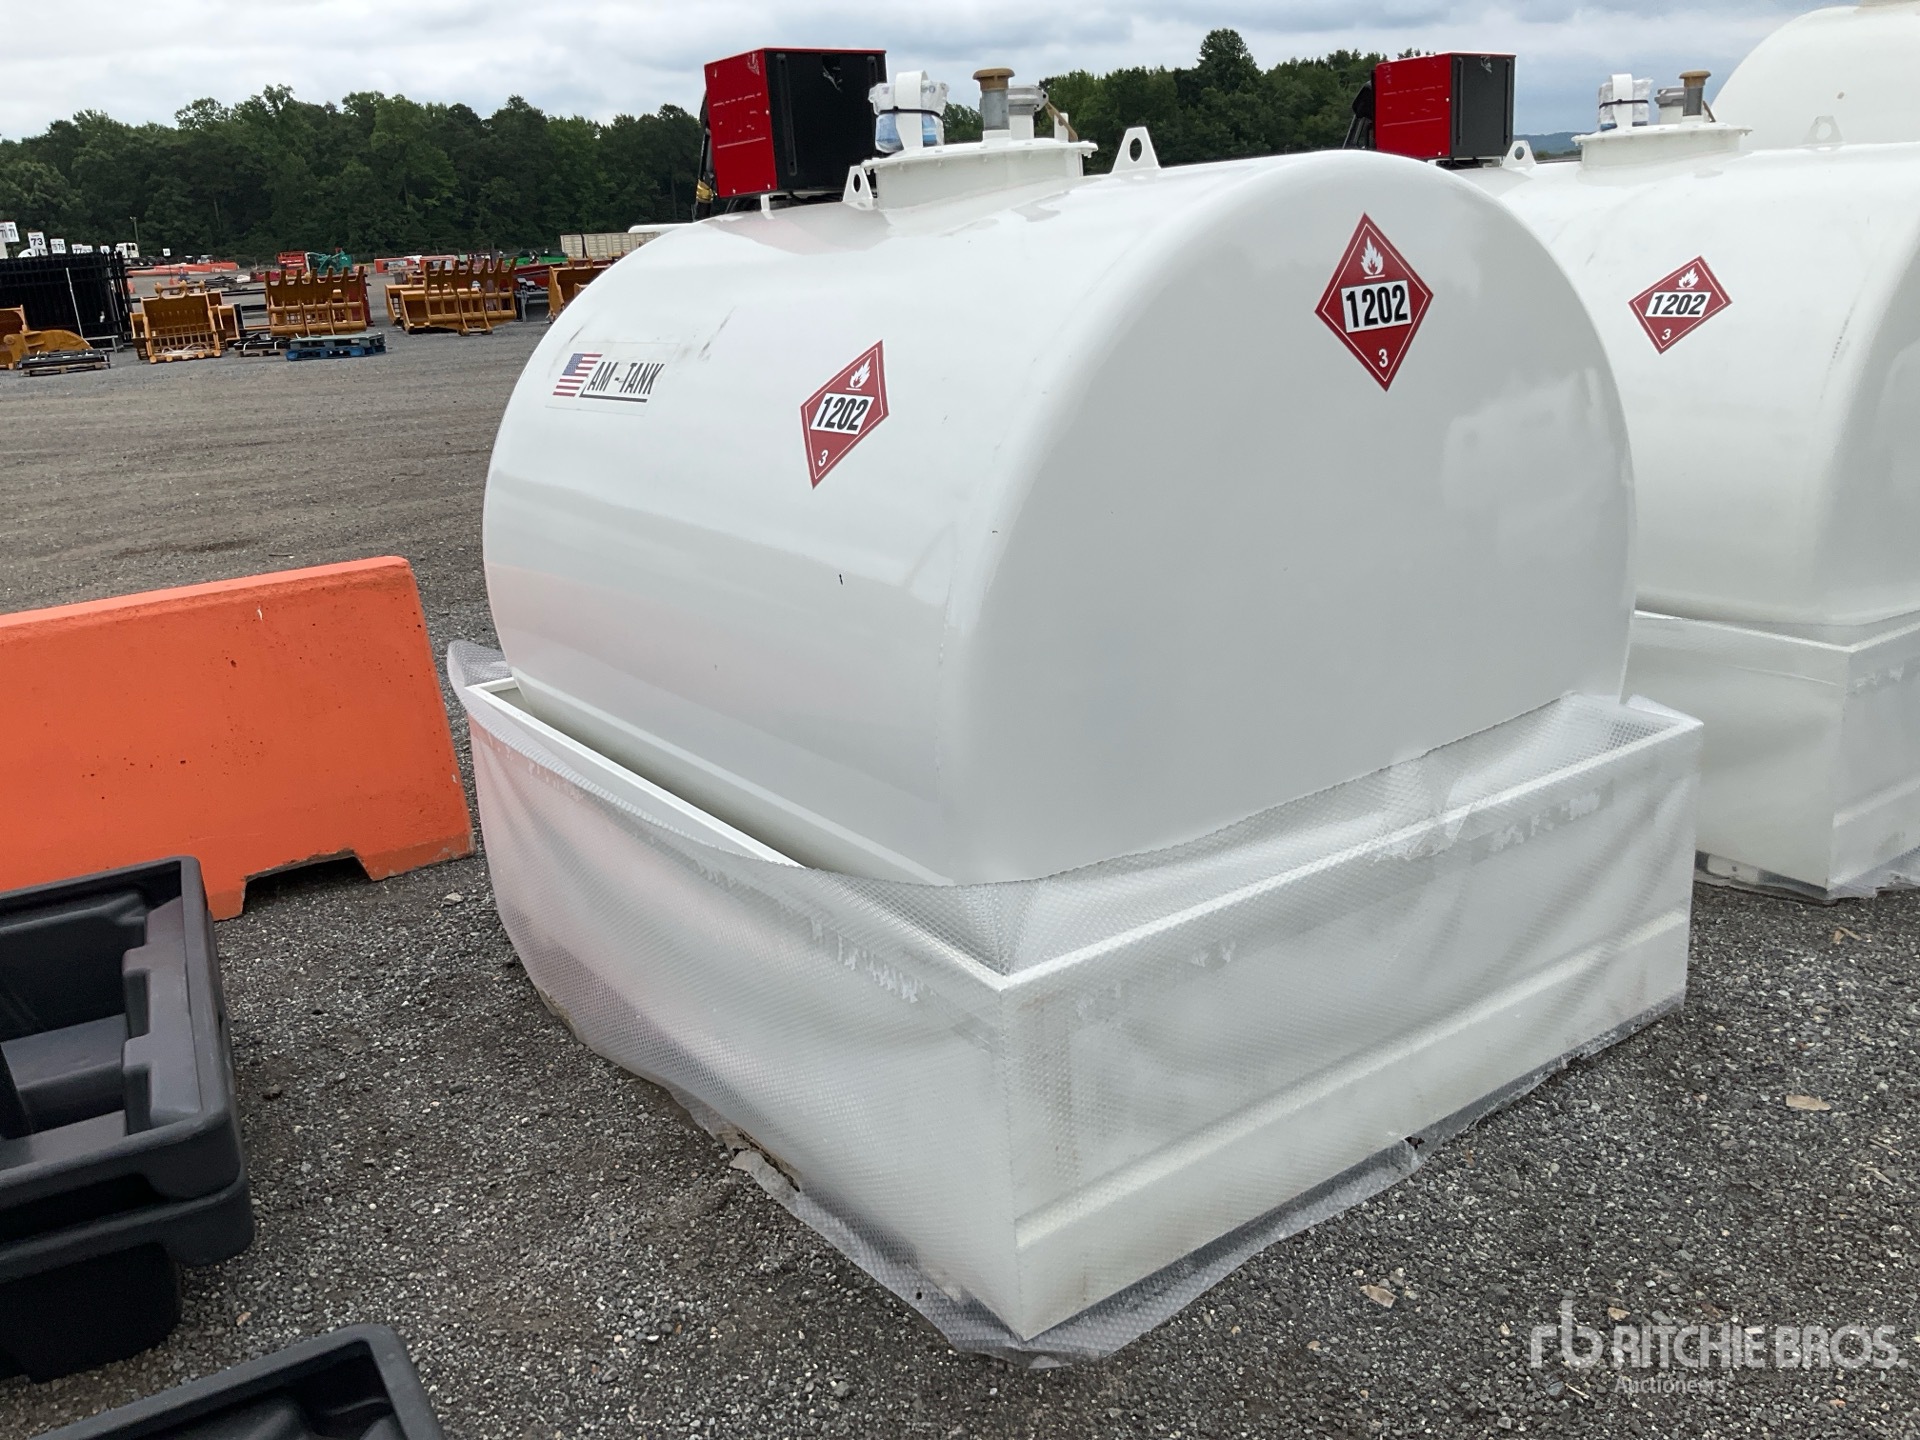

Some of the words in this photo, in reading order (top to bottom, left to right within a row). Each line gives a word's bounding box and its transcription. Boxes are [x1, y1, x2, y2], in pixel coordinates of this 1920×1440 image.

[31, 238, 43, 246] 73
[1345, 284, 1408, 328] 1202
[1651, 293, 1707, 316] 1202
[1661, 328, 1672, 341] 3
[1378, 349, 1389, 368] 3
[816, 396, 869, 431] 1202
[818, 450, 829, 467] 3
